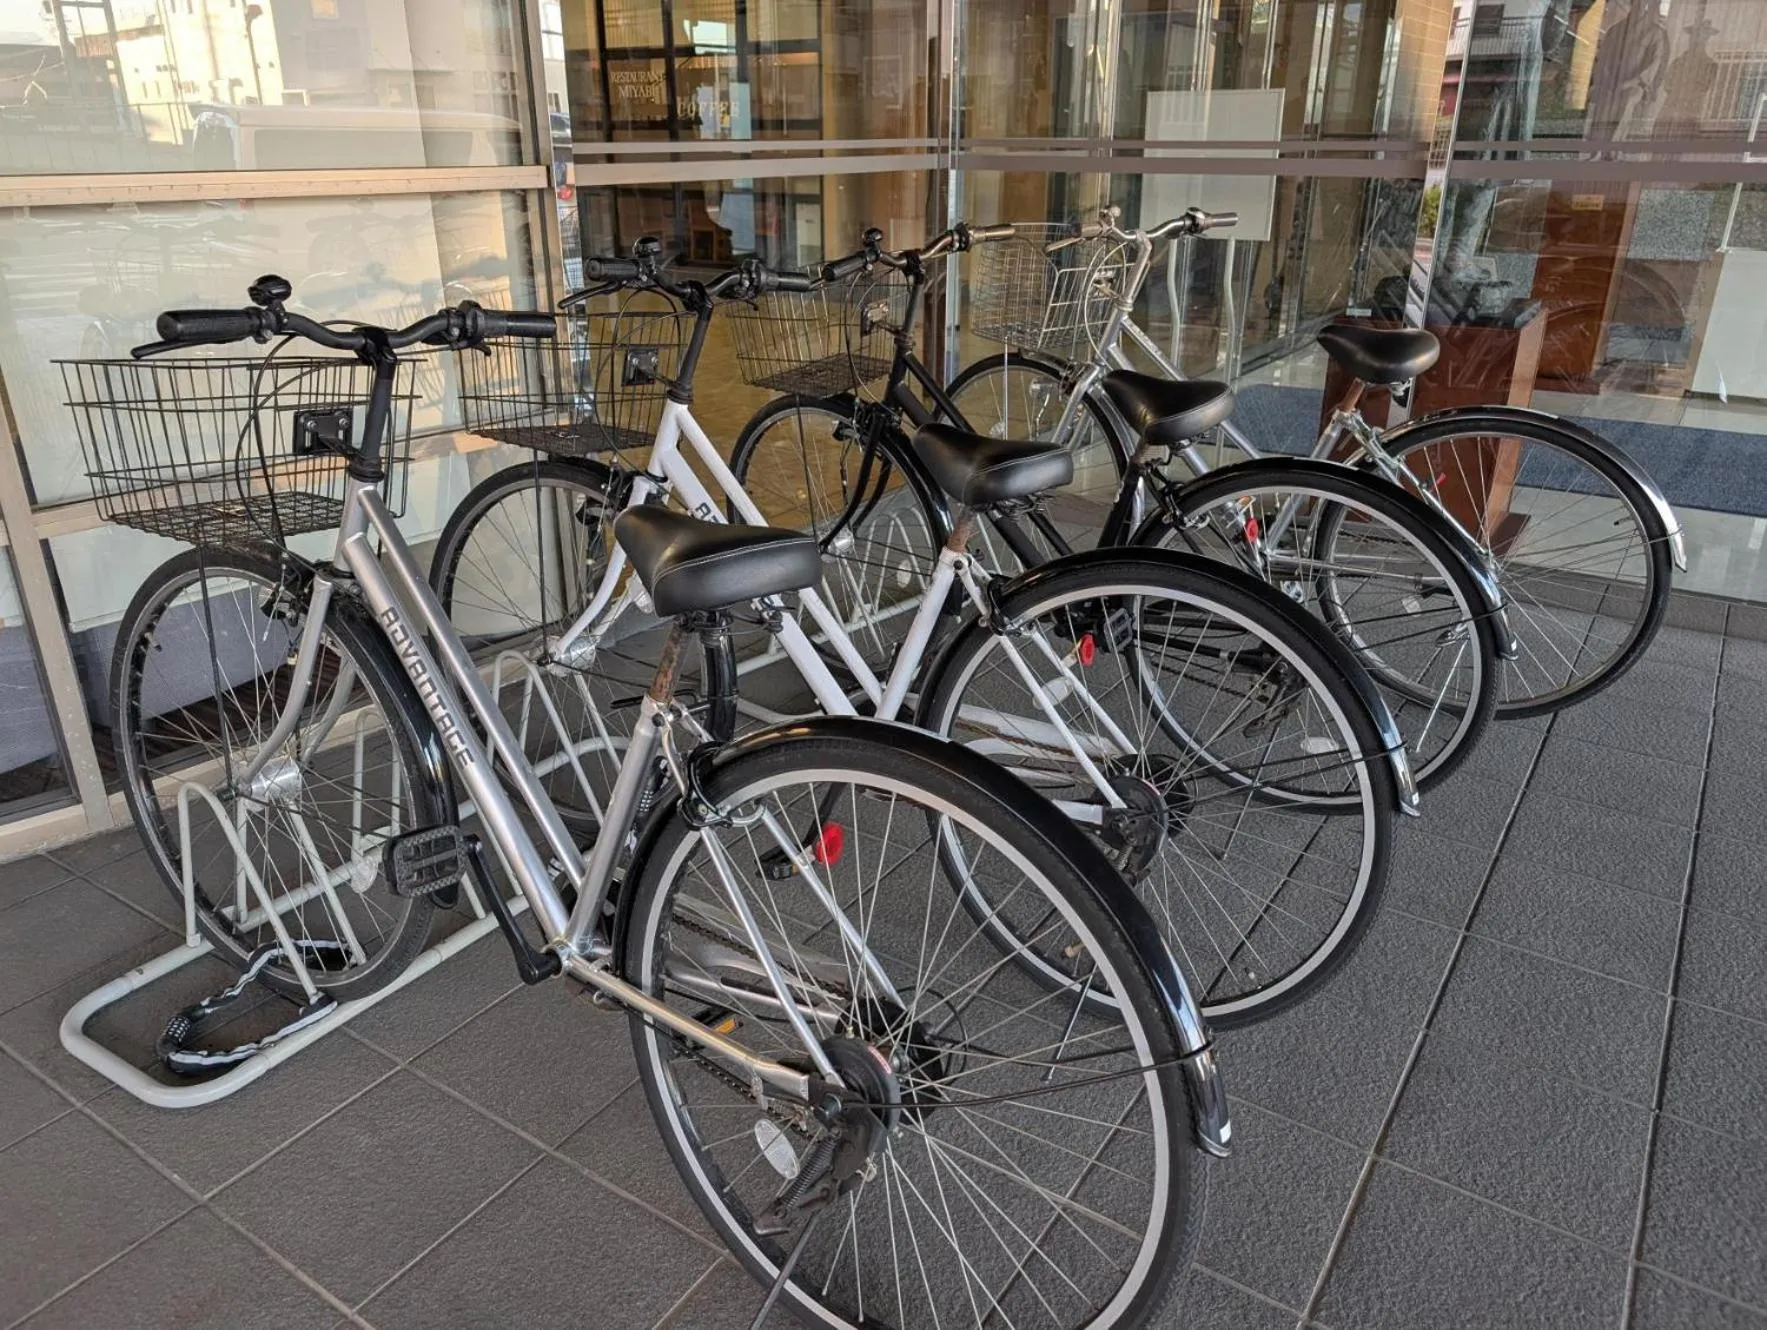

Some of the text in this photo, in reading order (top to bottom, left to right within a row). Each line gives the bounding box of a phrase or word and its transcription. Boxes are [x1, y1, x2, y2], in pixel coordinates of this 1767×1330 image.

[610, 71, 665, 83] RESTAURANT
[676, 100, 740, 118] COFFEE
[380, 606, 475, 770] ADVANTAGE
